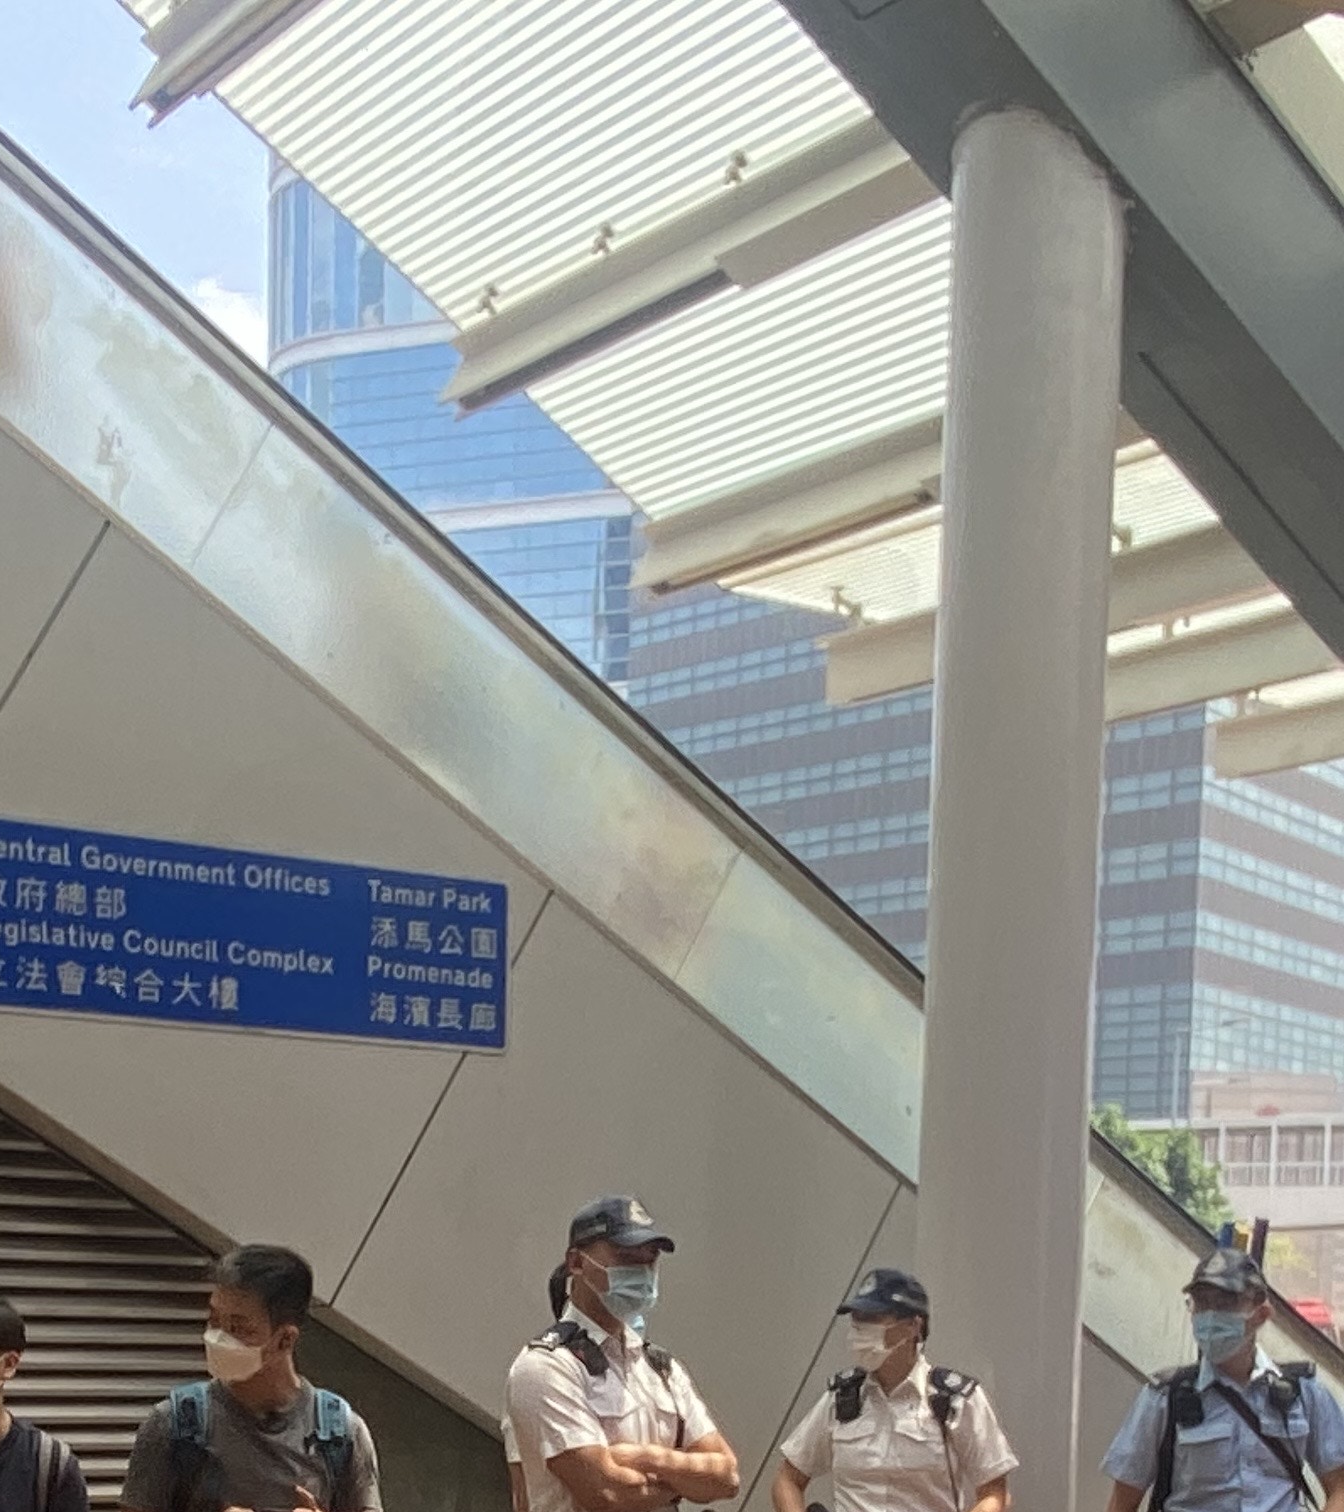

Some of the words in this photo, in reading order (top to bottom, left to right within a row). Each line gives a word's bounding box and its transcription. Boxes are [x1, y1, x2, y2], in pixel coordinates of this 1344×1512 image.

[80, 844, 236, 886] Government
[244, 864, 331, 896] Offices
[367, 879, 436, 907] Tamar
[442, 887, 492, 913] Park
[122, 929, 219, 963] Council
[227, 940, 335, 975] Complex
[370, 916, 498, 960] 添馬公園
[367, 955, 494, 989] Promenade
[369, 991, 497, 1031] 海濱長廊
